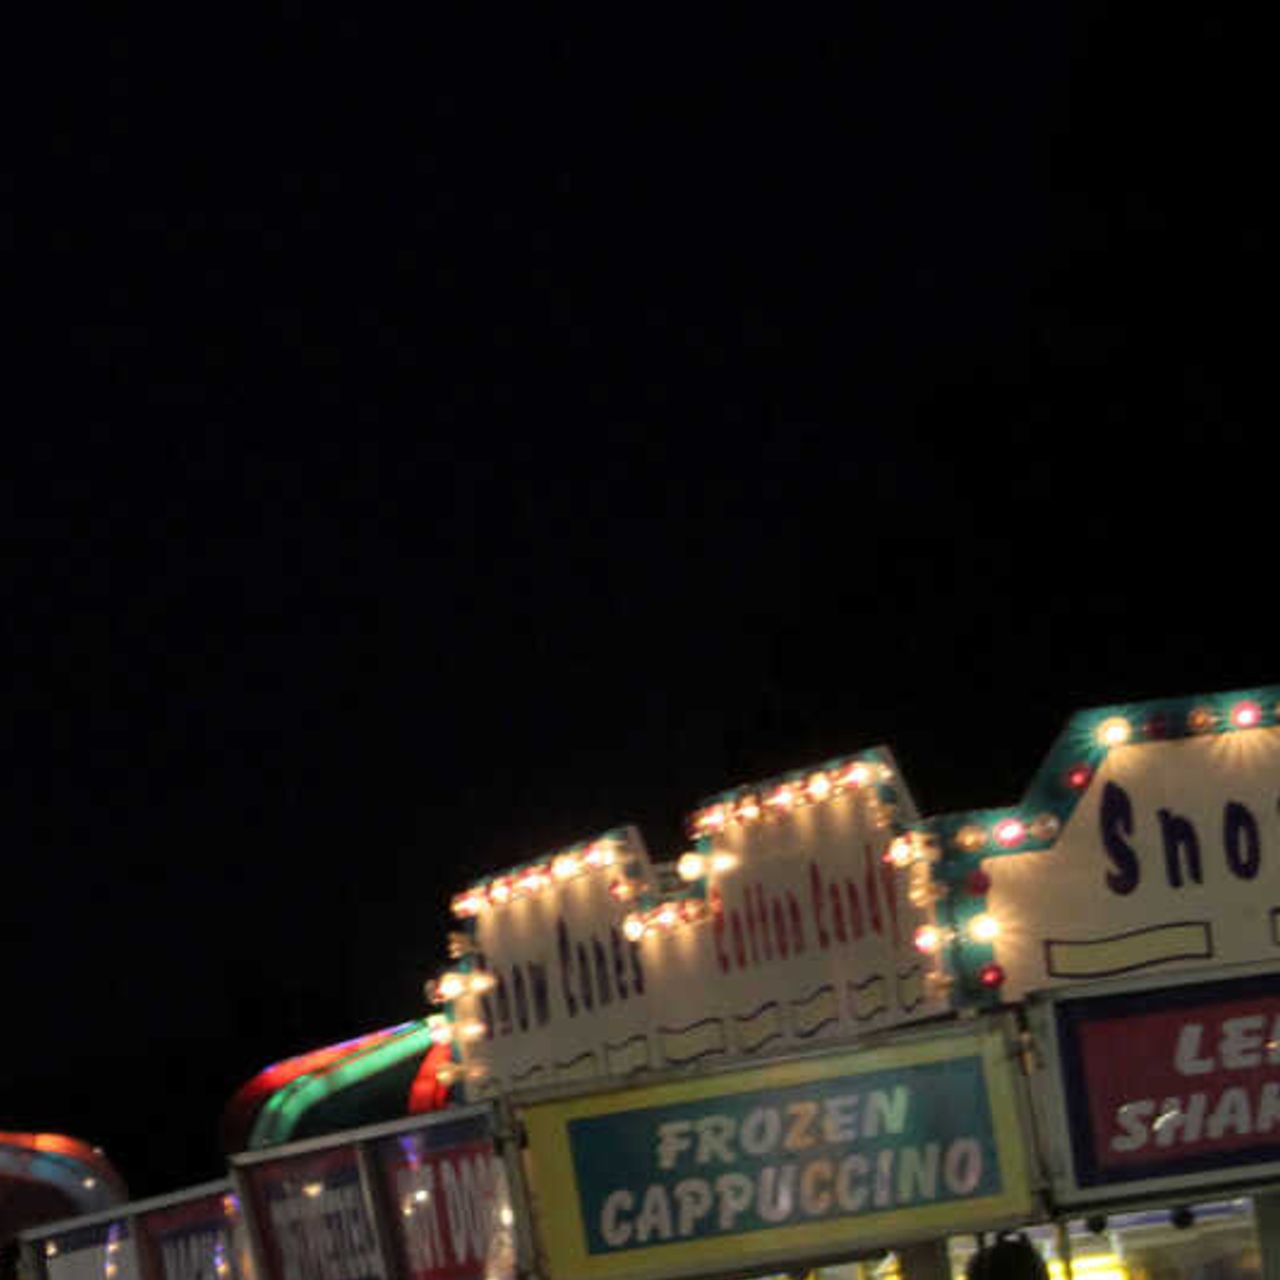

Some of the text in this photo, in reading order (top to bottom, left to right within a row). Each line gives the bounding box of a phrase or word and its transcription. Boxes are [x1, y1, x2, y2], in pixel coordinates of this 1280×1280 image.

[1100, 780, 1280, 896] Sno
[1174, 1014, 1280, 1076] LE
[654, 1085, 912, 1171] FROZEN
[599, 1137, 984, 1249] CAPPUCCINO
